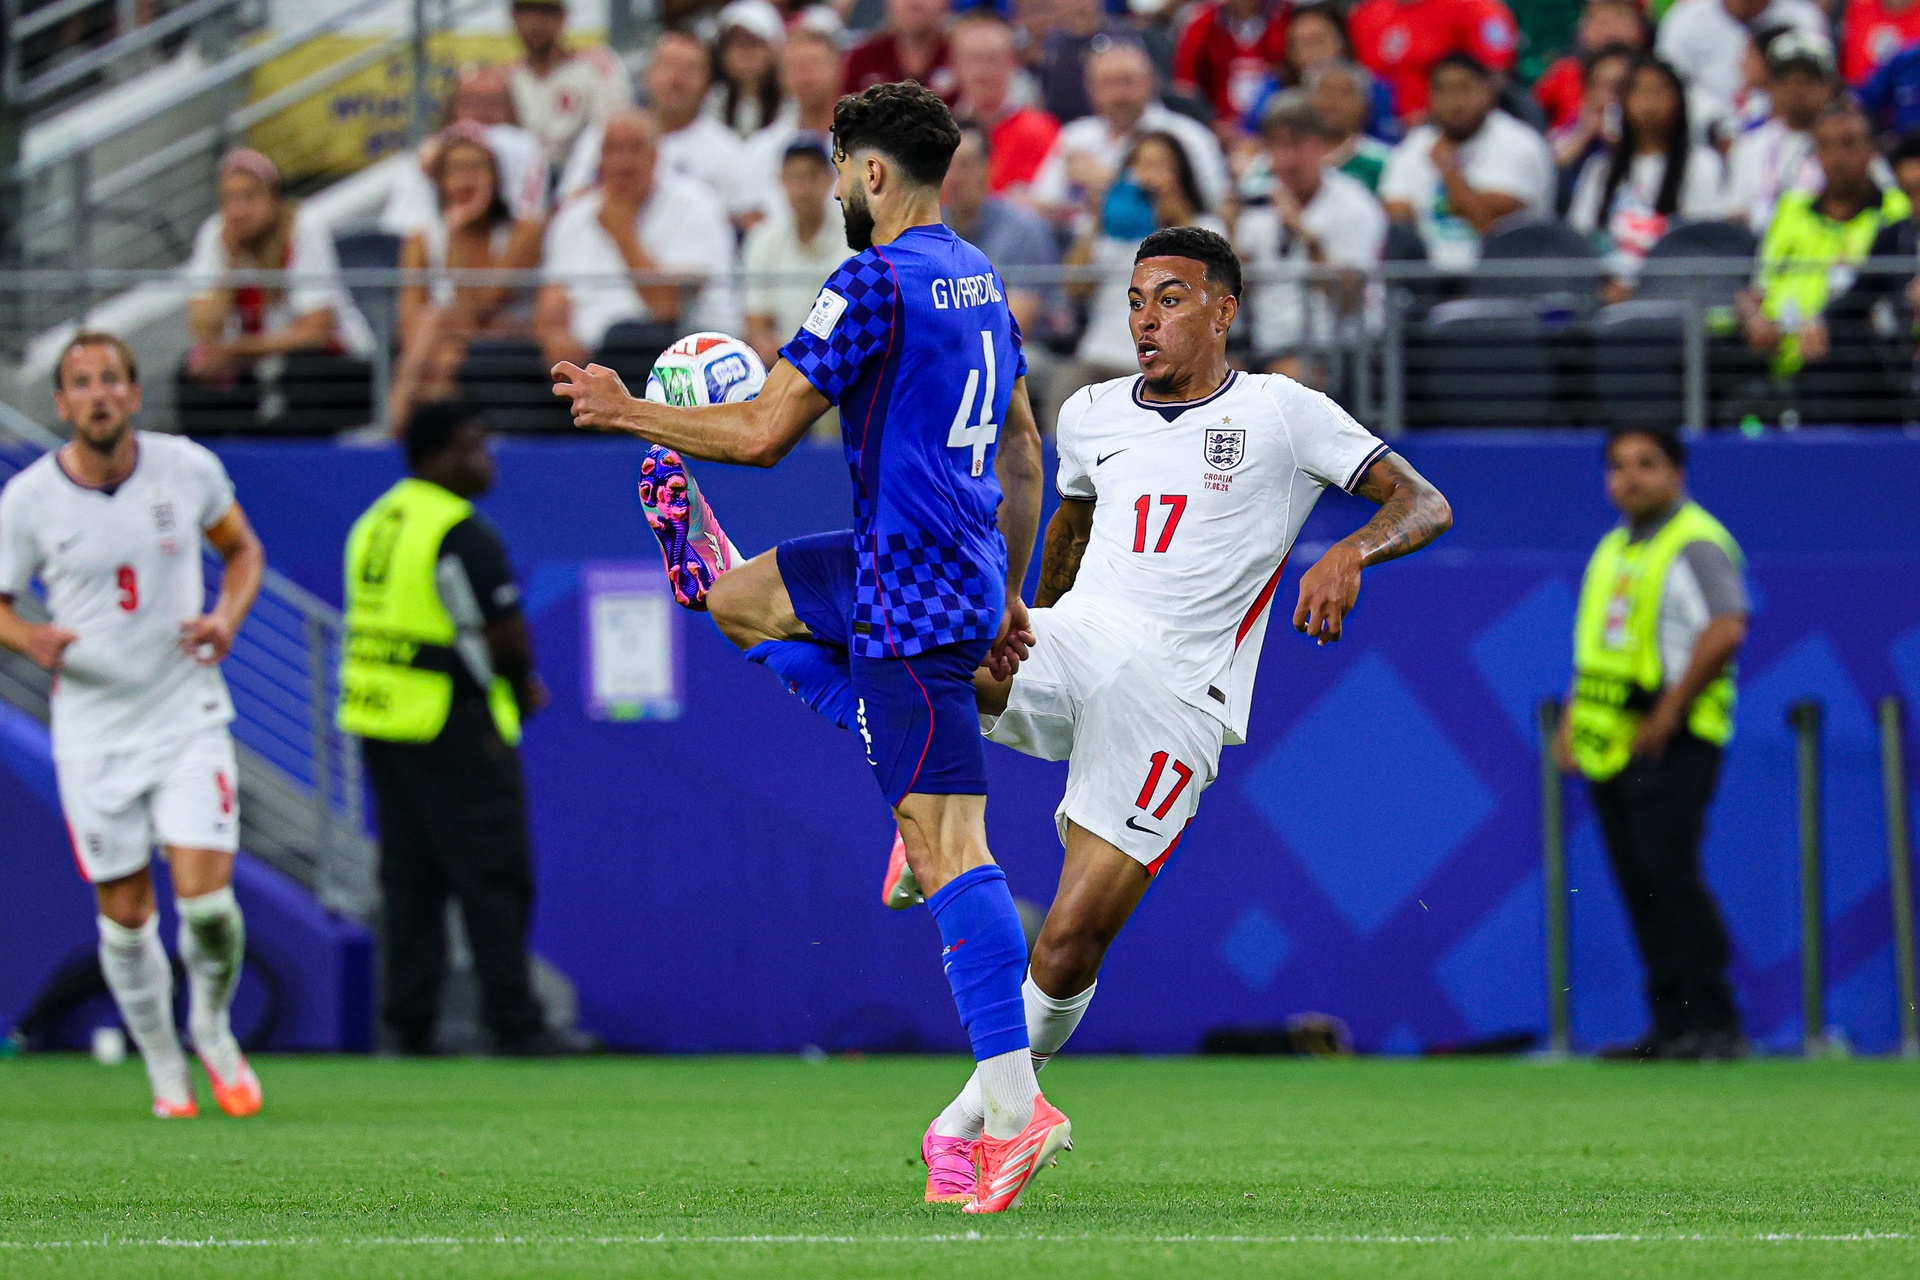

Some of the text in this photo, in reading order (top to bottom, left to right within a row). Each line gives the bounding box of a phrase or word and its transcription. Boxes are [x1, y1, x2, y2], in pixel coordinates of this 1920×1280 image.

[946, 330, 998, 477] 4
[1203, 472, 1233, 484] CROATIA
[1204, 481, 1230, 492] 17.06.26
[1132, 494, 1188, 553] 17
[116, 564, 139, 613] 9
[1134, 750, 1194, 821] 17
